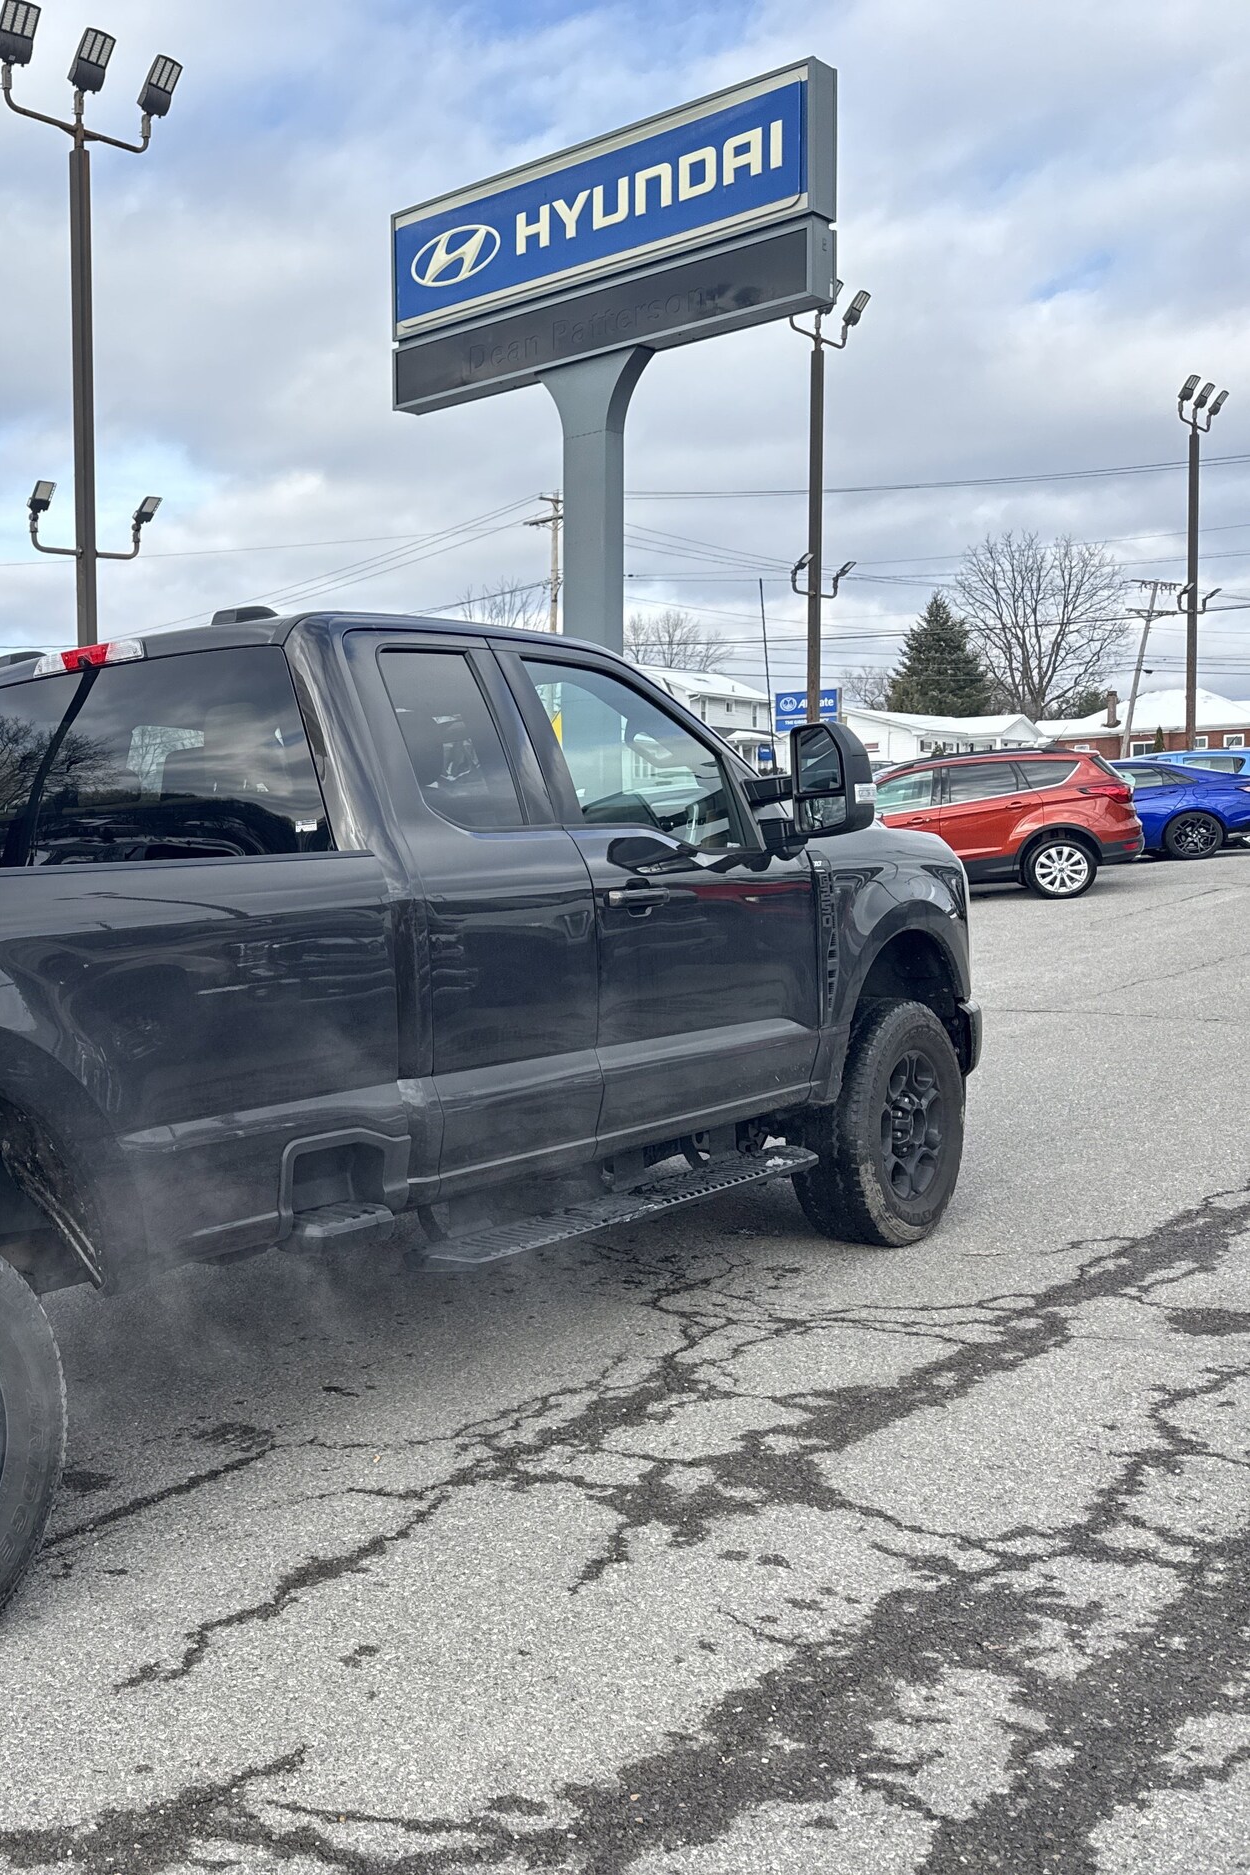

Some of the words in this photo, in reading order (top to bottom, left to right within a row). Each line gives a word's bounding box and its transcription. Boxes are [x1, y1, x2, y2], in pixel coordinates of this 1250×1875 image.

[515, 119, 783, 255] HYUNDAI
[468, 334, 539, 375] Dean
[552, 287, 705, 350] Patterson
[798, 697, 834, 709] Alate
